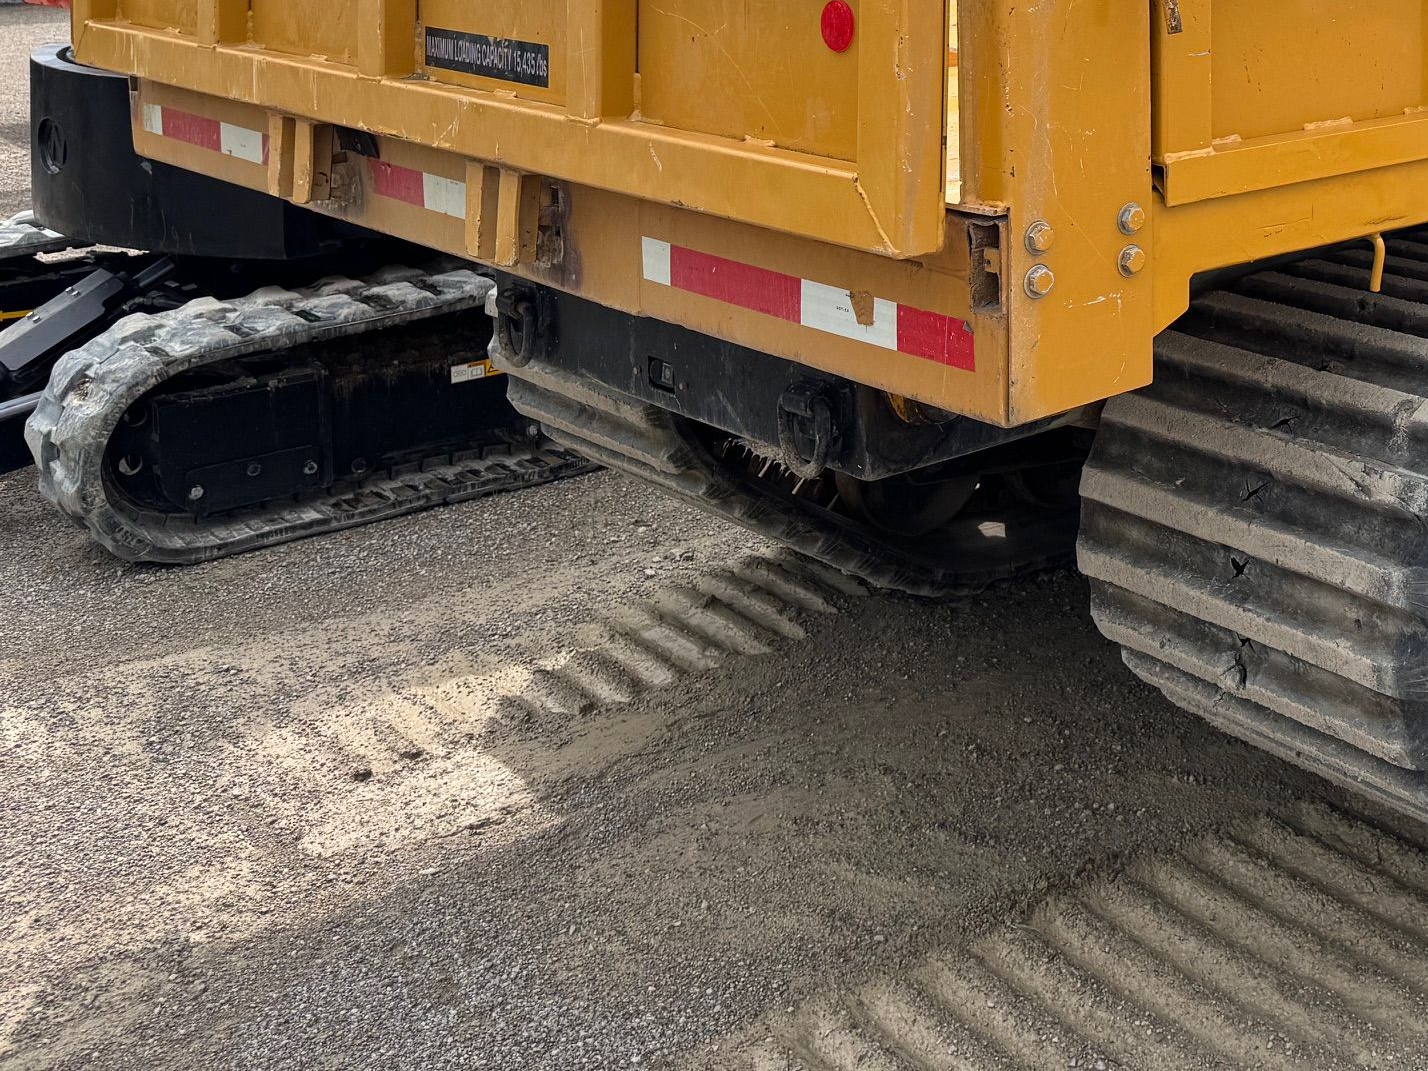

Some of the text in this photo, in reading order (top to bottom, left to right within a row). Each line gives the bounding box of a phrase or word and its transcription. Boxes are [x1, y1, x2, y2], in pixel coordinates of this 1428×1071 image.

[426, 35, 454, 60] MAXIMUM
[455, 39, 481, 65] LOADING
[481, 44, 512, 70] CAPACITY
[513, 50, 536, 77] 15,435
